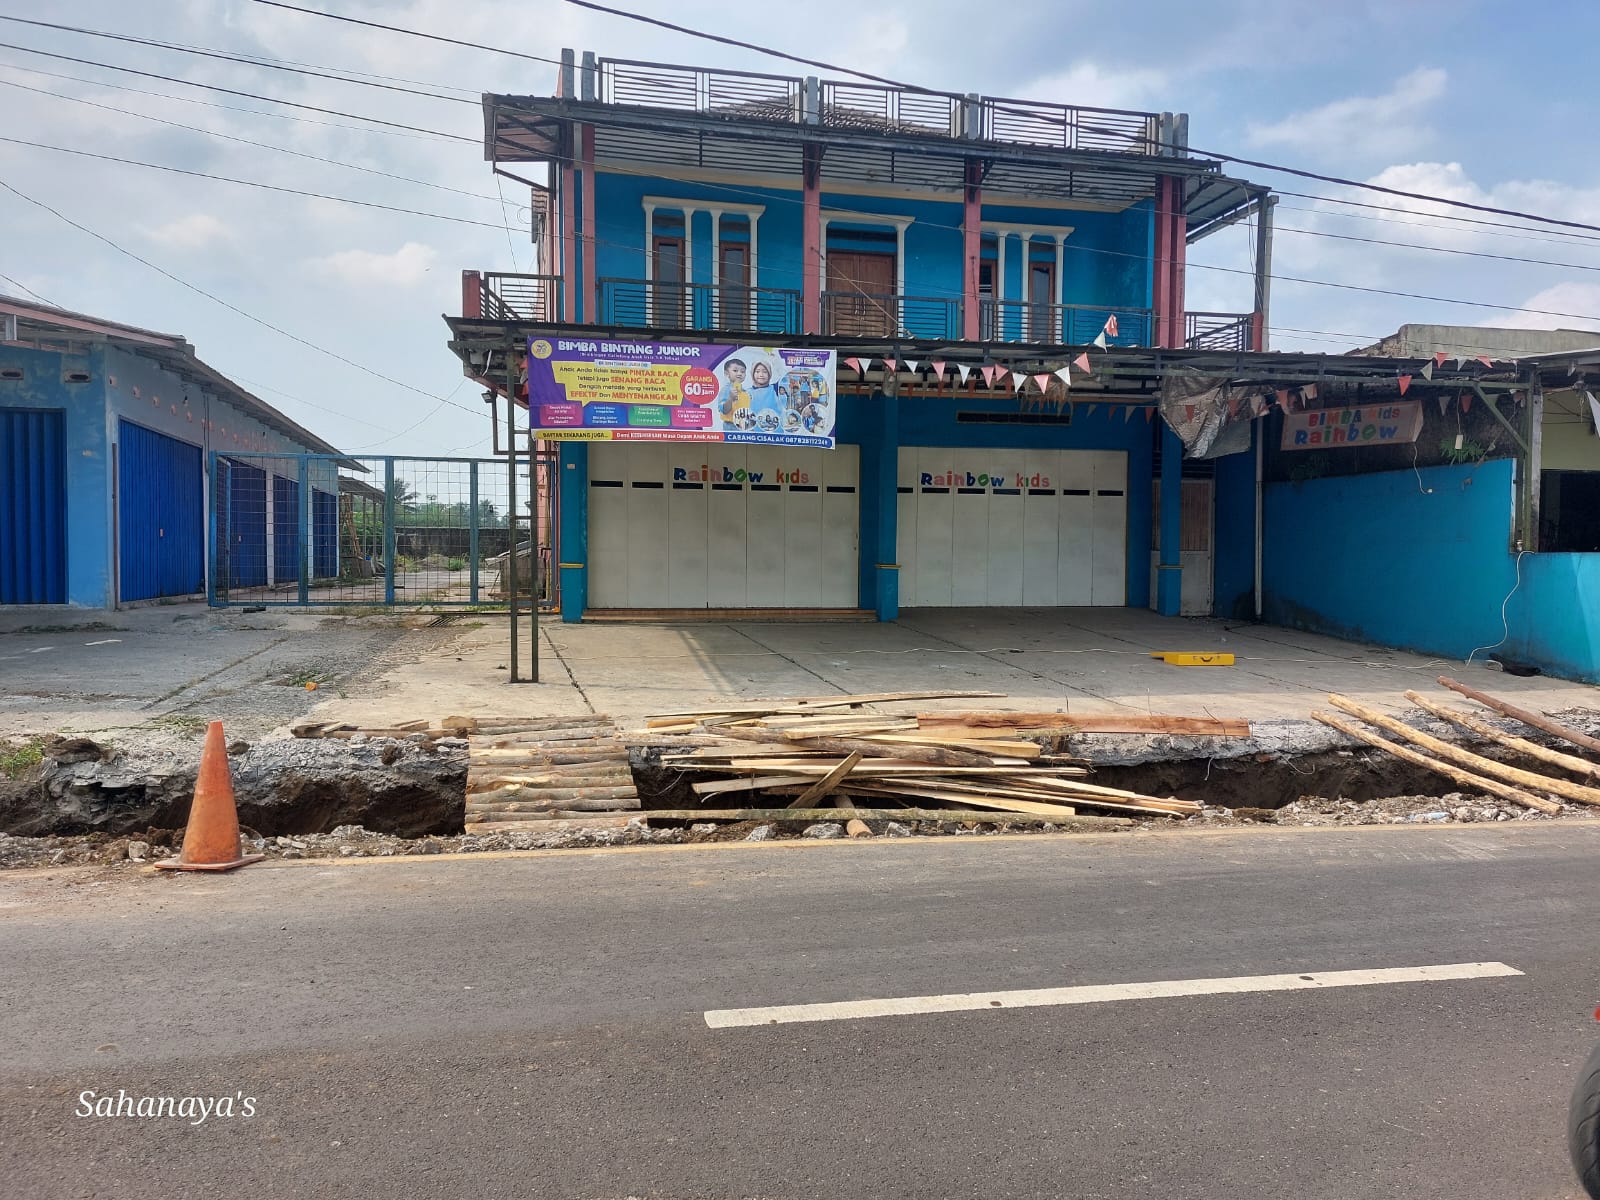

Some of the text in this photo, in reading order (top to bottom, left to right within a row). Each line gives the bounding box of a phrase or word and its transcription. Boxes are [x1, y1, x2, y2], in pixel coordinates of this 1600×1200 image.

[558, 340, 597, 352] BIMBA
[601, 342, 654, 355] BINTANG
[657, 345, 701, 357] JUNIOR
[610, 376, 639, 384] SENANG
[644, 377, 666, 385] BACA
[628, 369, 655, 377] PINTAR
[611, 392, 678, 401] MENYENANGKAN
[685, 383, 702, 396] 60
[1308, 409, 1362, 427] BIMBA
[757, 435, 785, 443] CISALAK
[1294, 423, 1399, 445] Rainbow
[673, 464, 810, 484] Rainbow kids
[920, 470, 1050, 488] Rainbow kids
